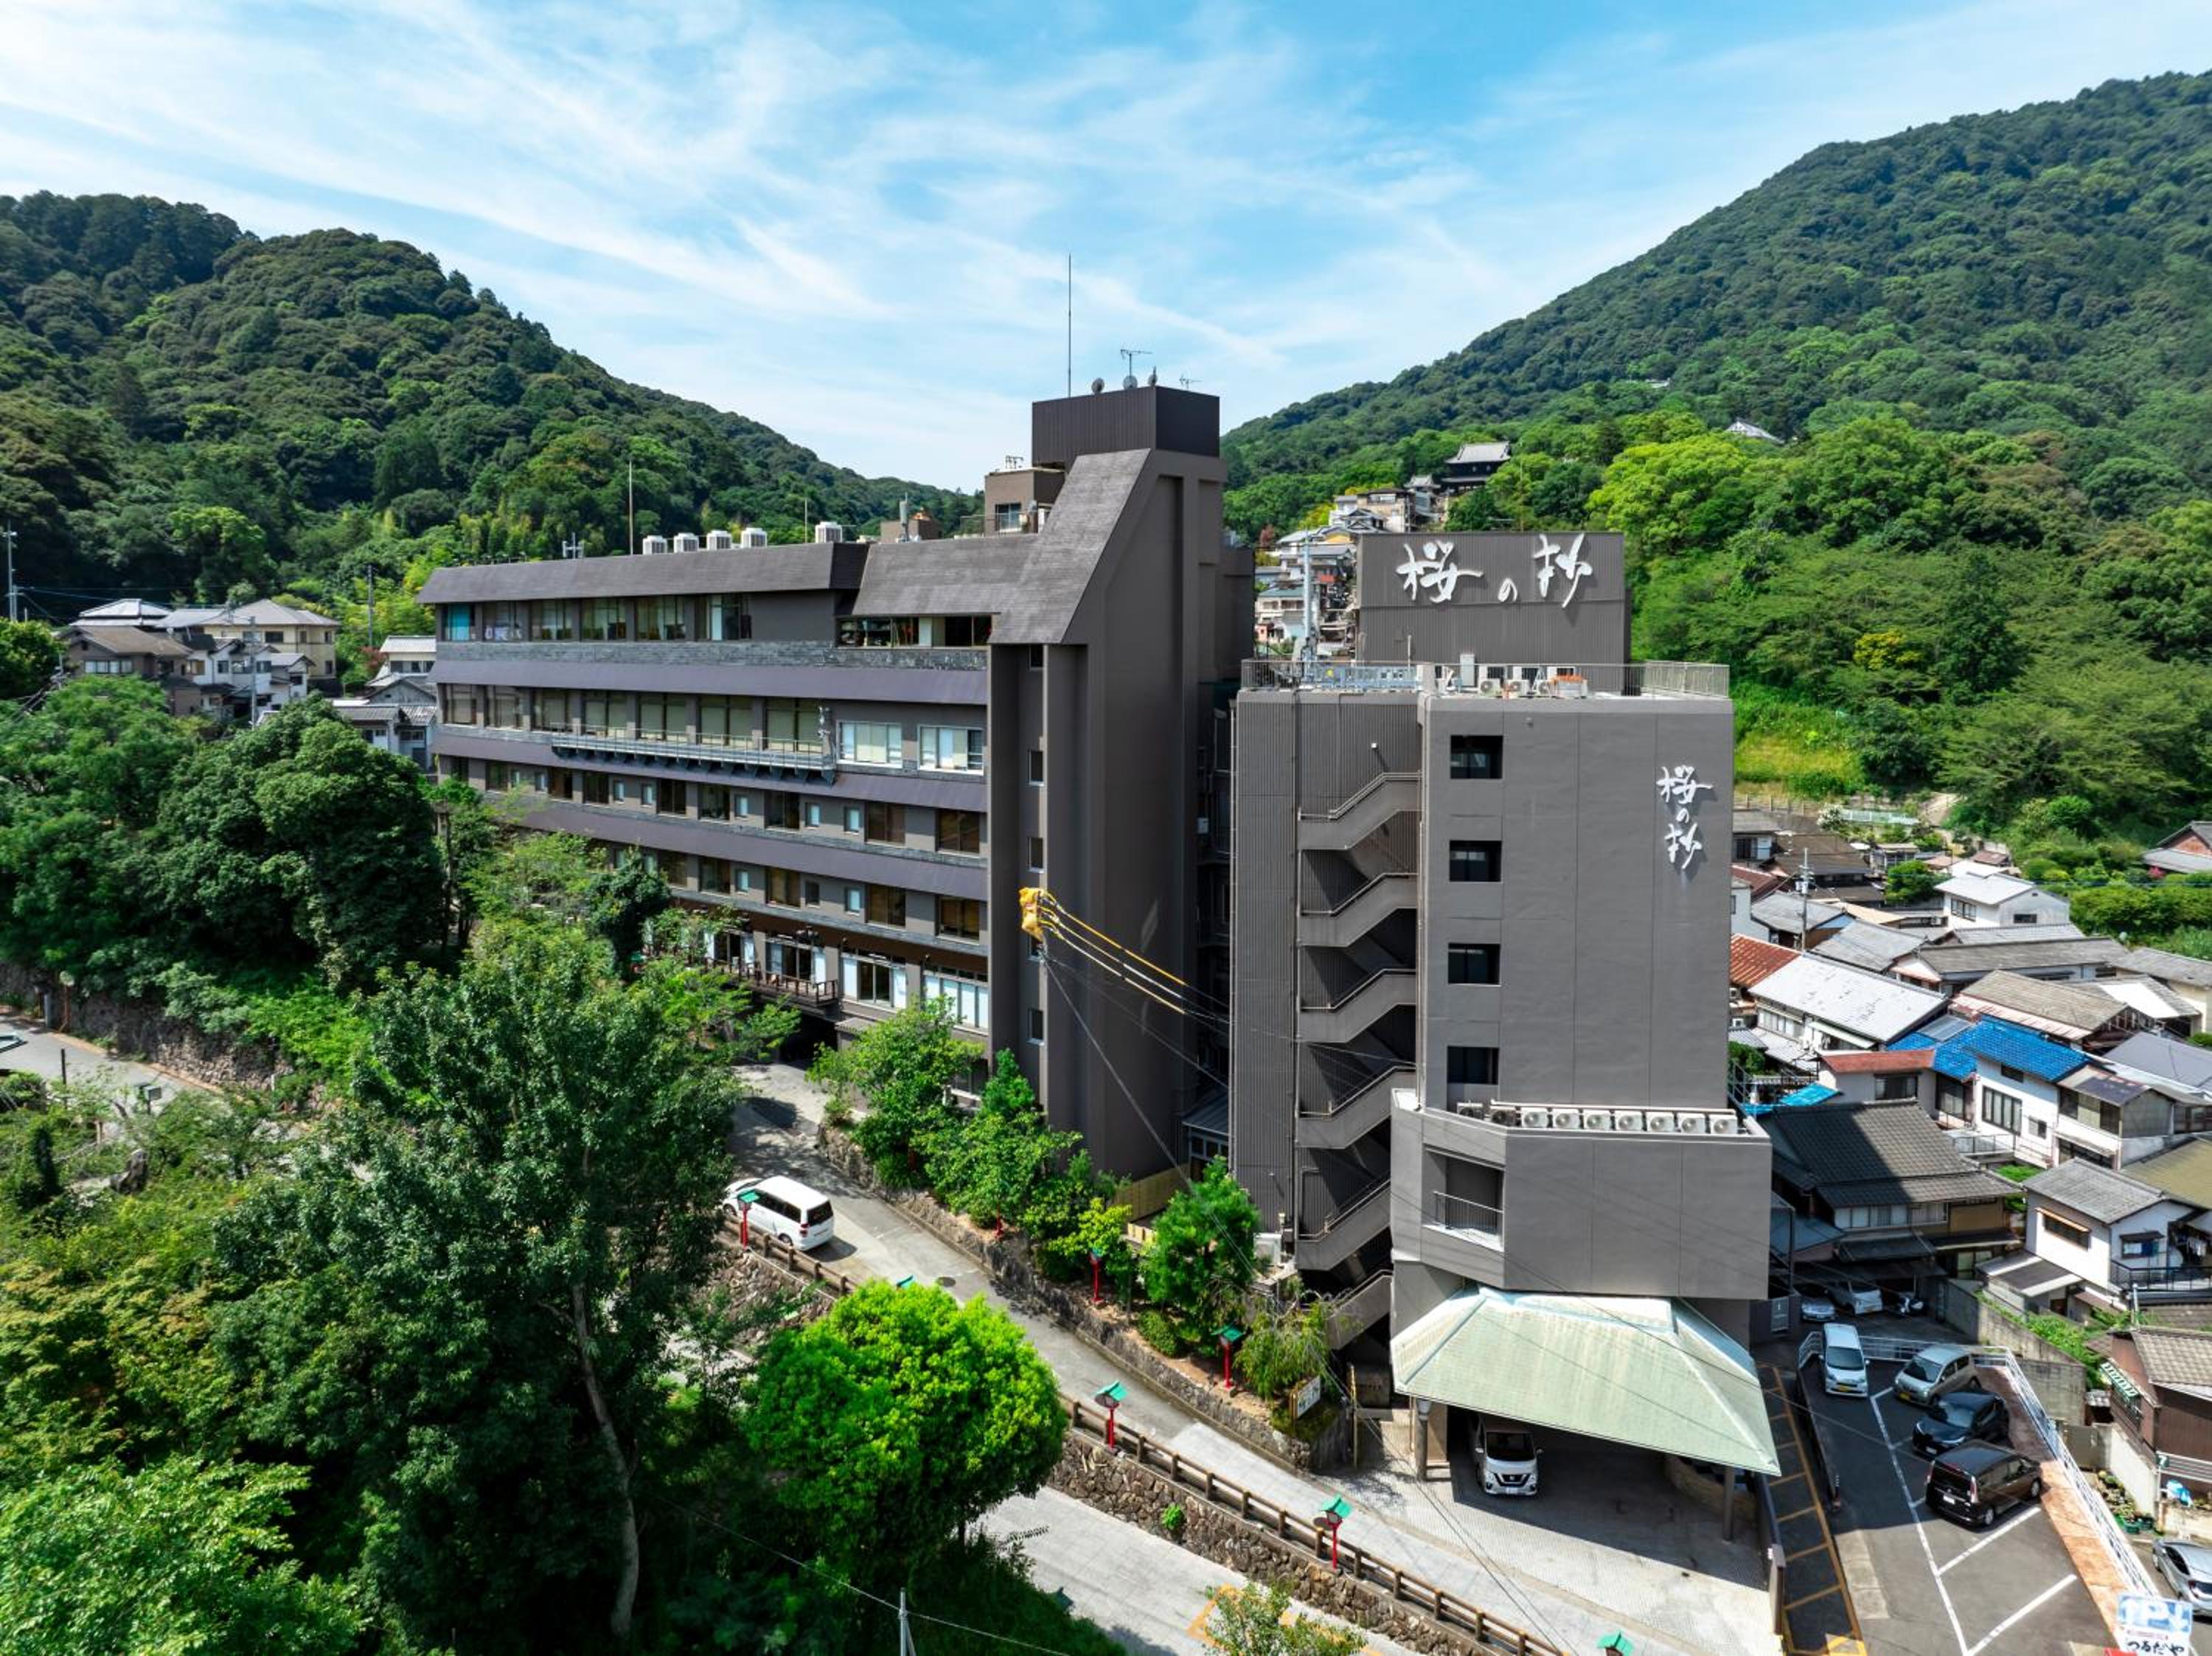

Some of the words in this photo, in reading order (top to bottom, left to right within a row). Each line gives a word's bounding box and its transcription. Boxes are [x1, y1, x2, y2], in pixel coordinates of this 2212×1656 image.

[1395, 532, 1593, 608] 桜の抄
[1656, 765, 1714, 870] 桜の抄
